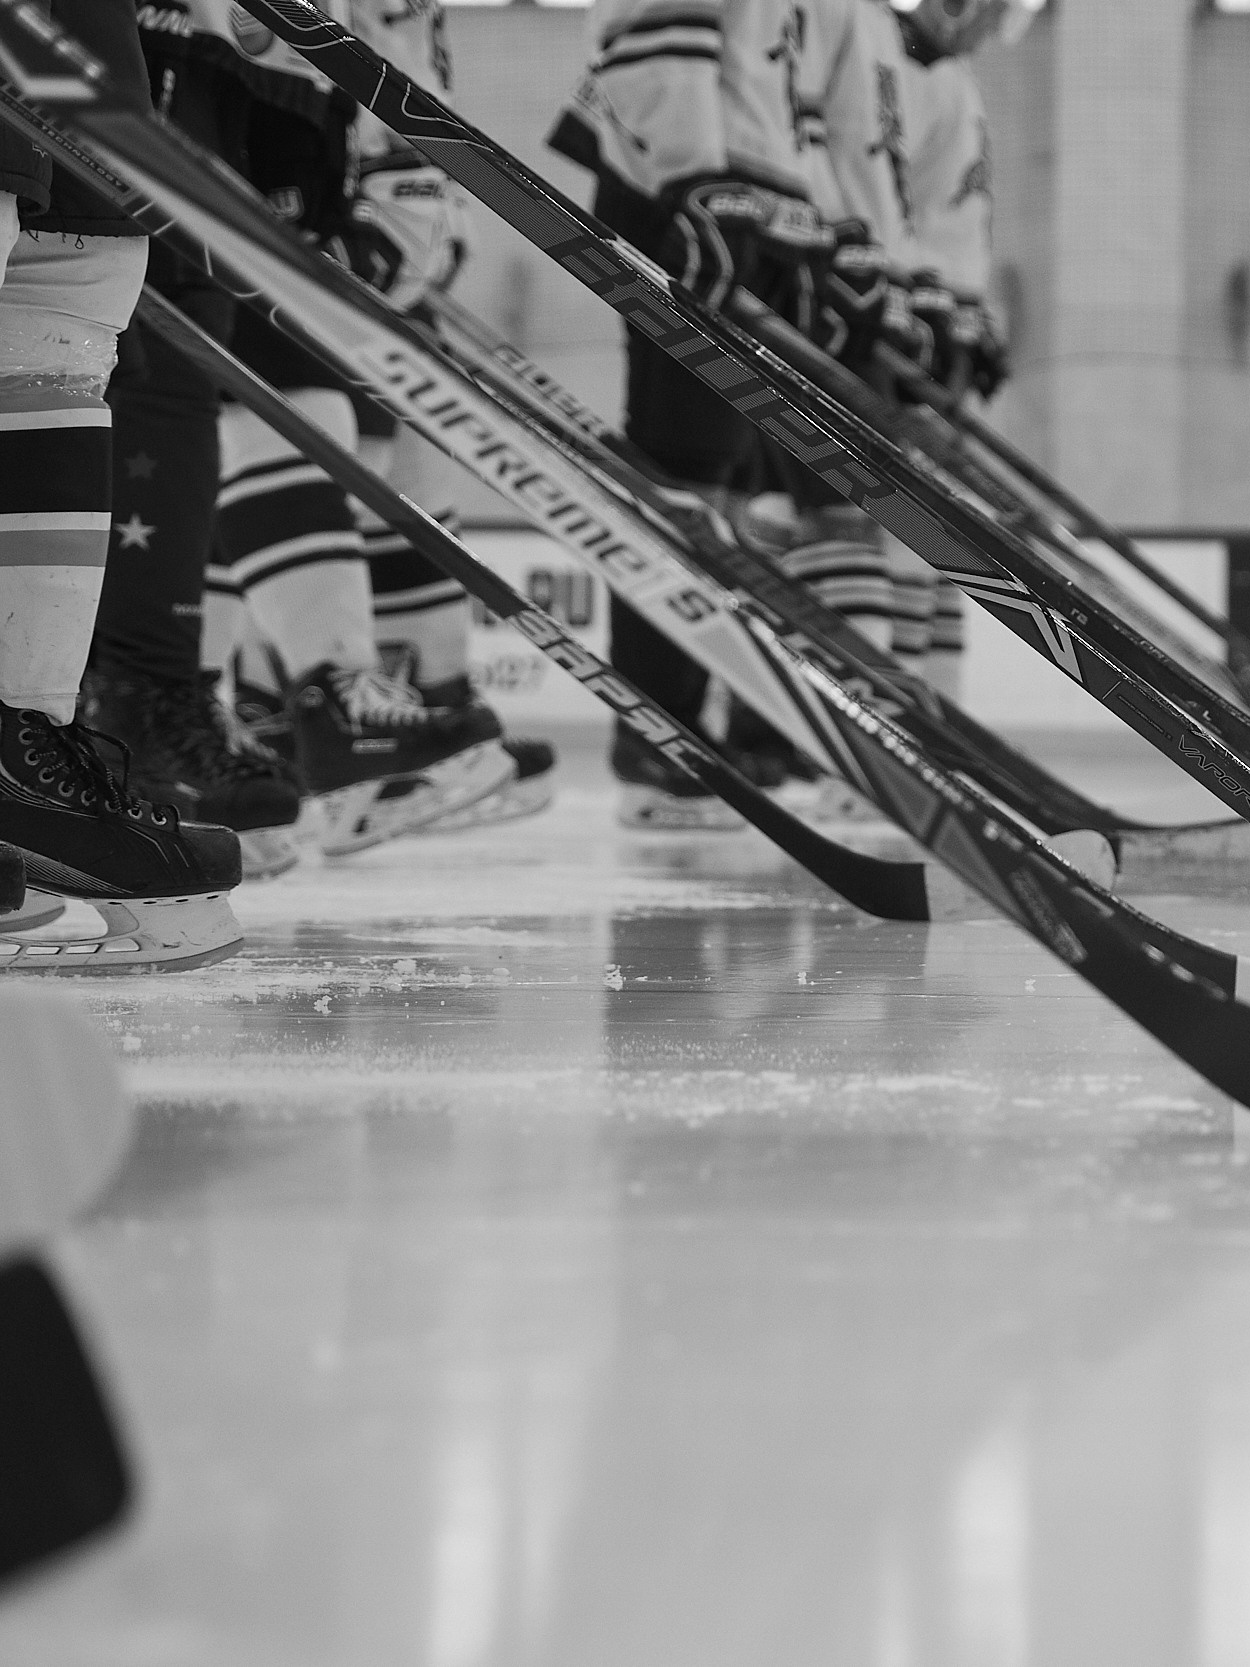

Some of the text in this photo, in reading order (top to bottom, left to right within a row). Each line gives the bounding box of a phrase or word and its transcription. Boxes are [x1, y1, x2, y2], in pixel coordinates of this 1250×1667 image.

[41, 124, 122, 187] TECHNOLOGY
[362, 350, 647, 580] SUPREME
[542, 233, 896, 507] BAUER
